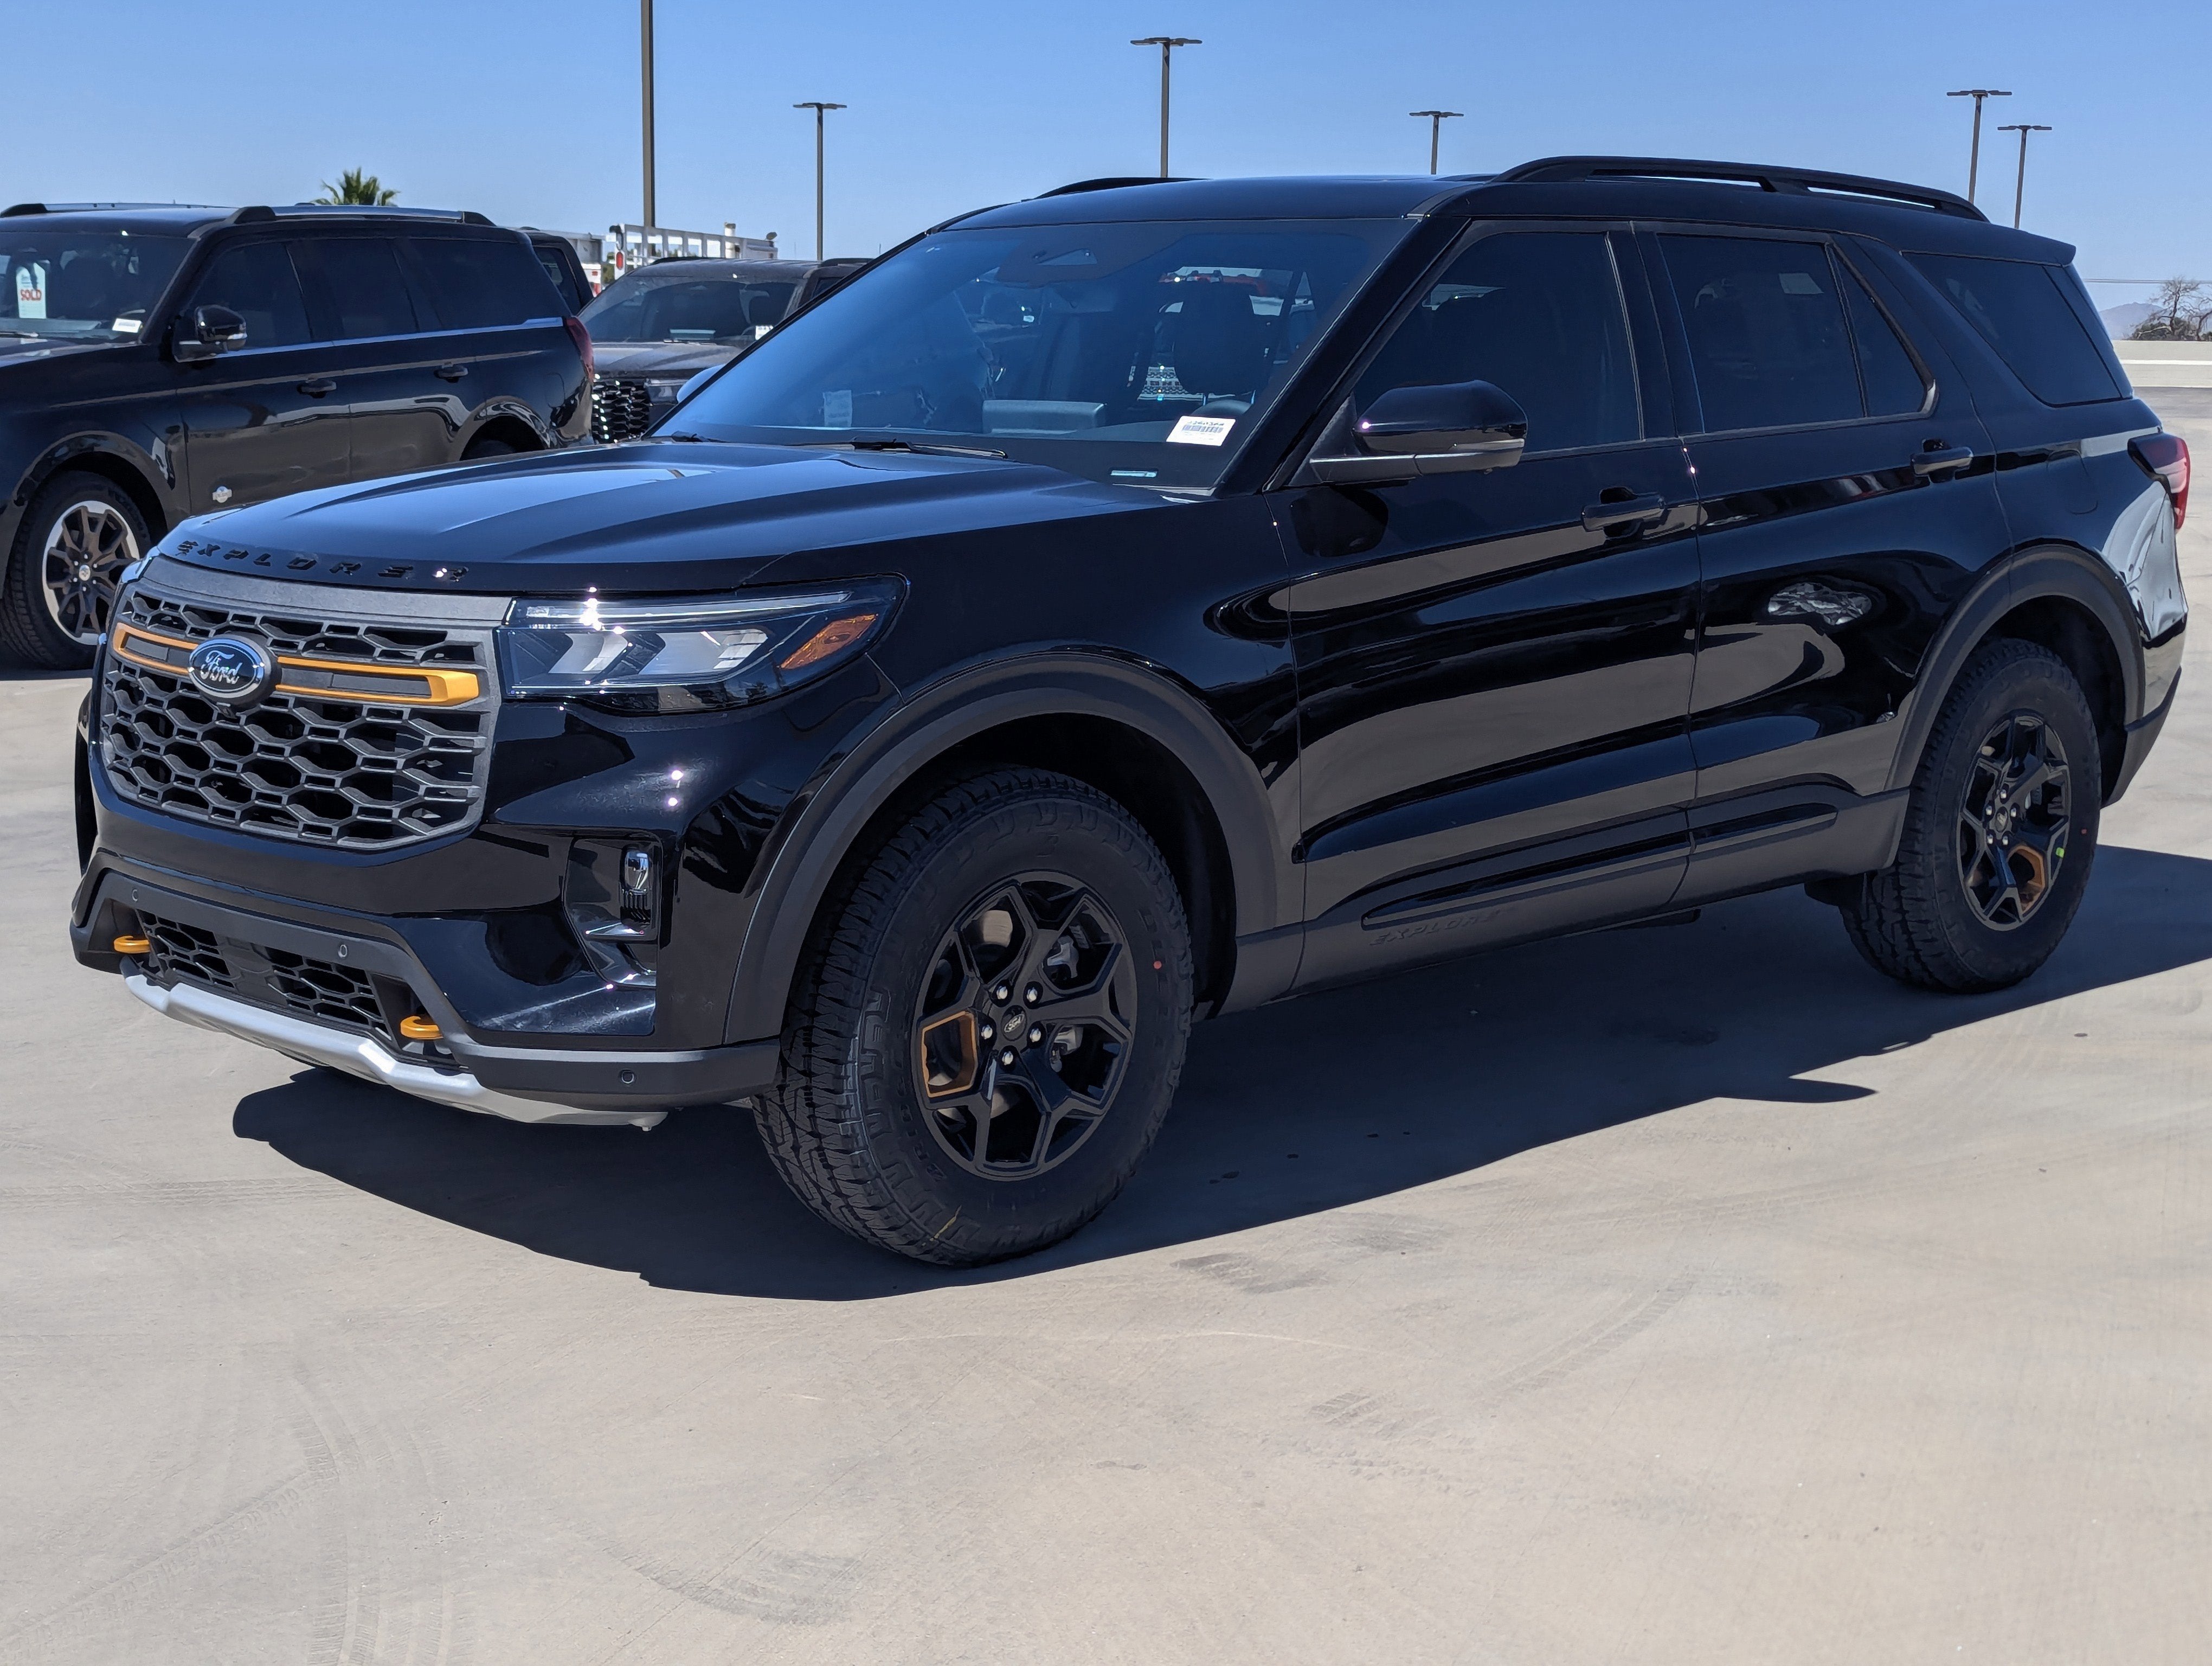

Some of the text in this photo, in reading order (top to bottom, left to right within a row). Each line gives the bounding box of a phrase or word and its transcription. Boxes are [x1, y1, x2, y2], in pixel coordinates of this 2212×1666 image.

[21, 289, 42, 301] SOLD
[175, 540, 470, 583] EXPLORER
[200, 650, 243, 685] Ford
